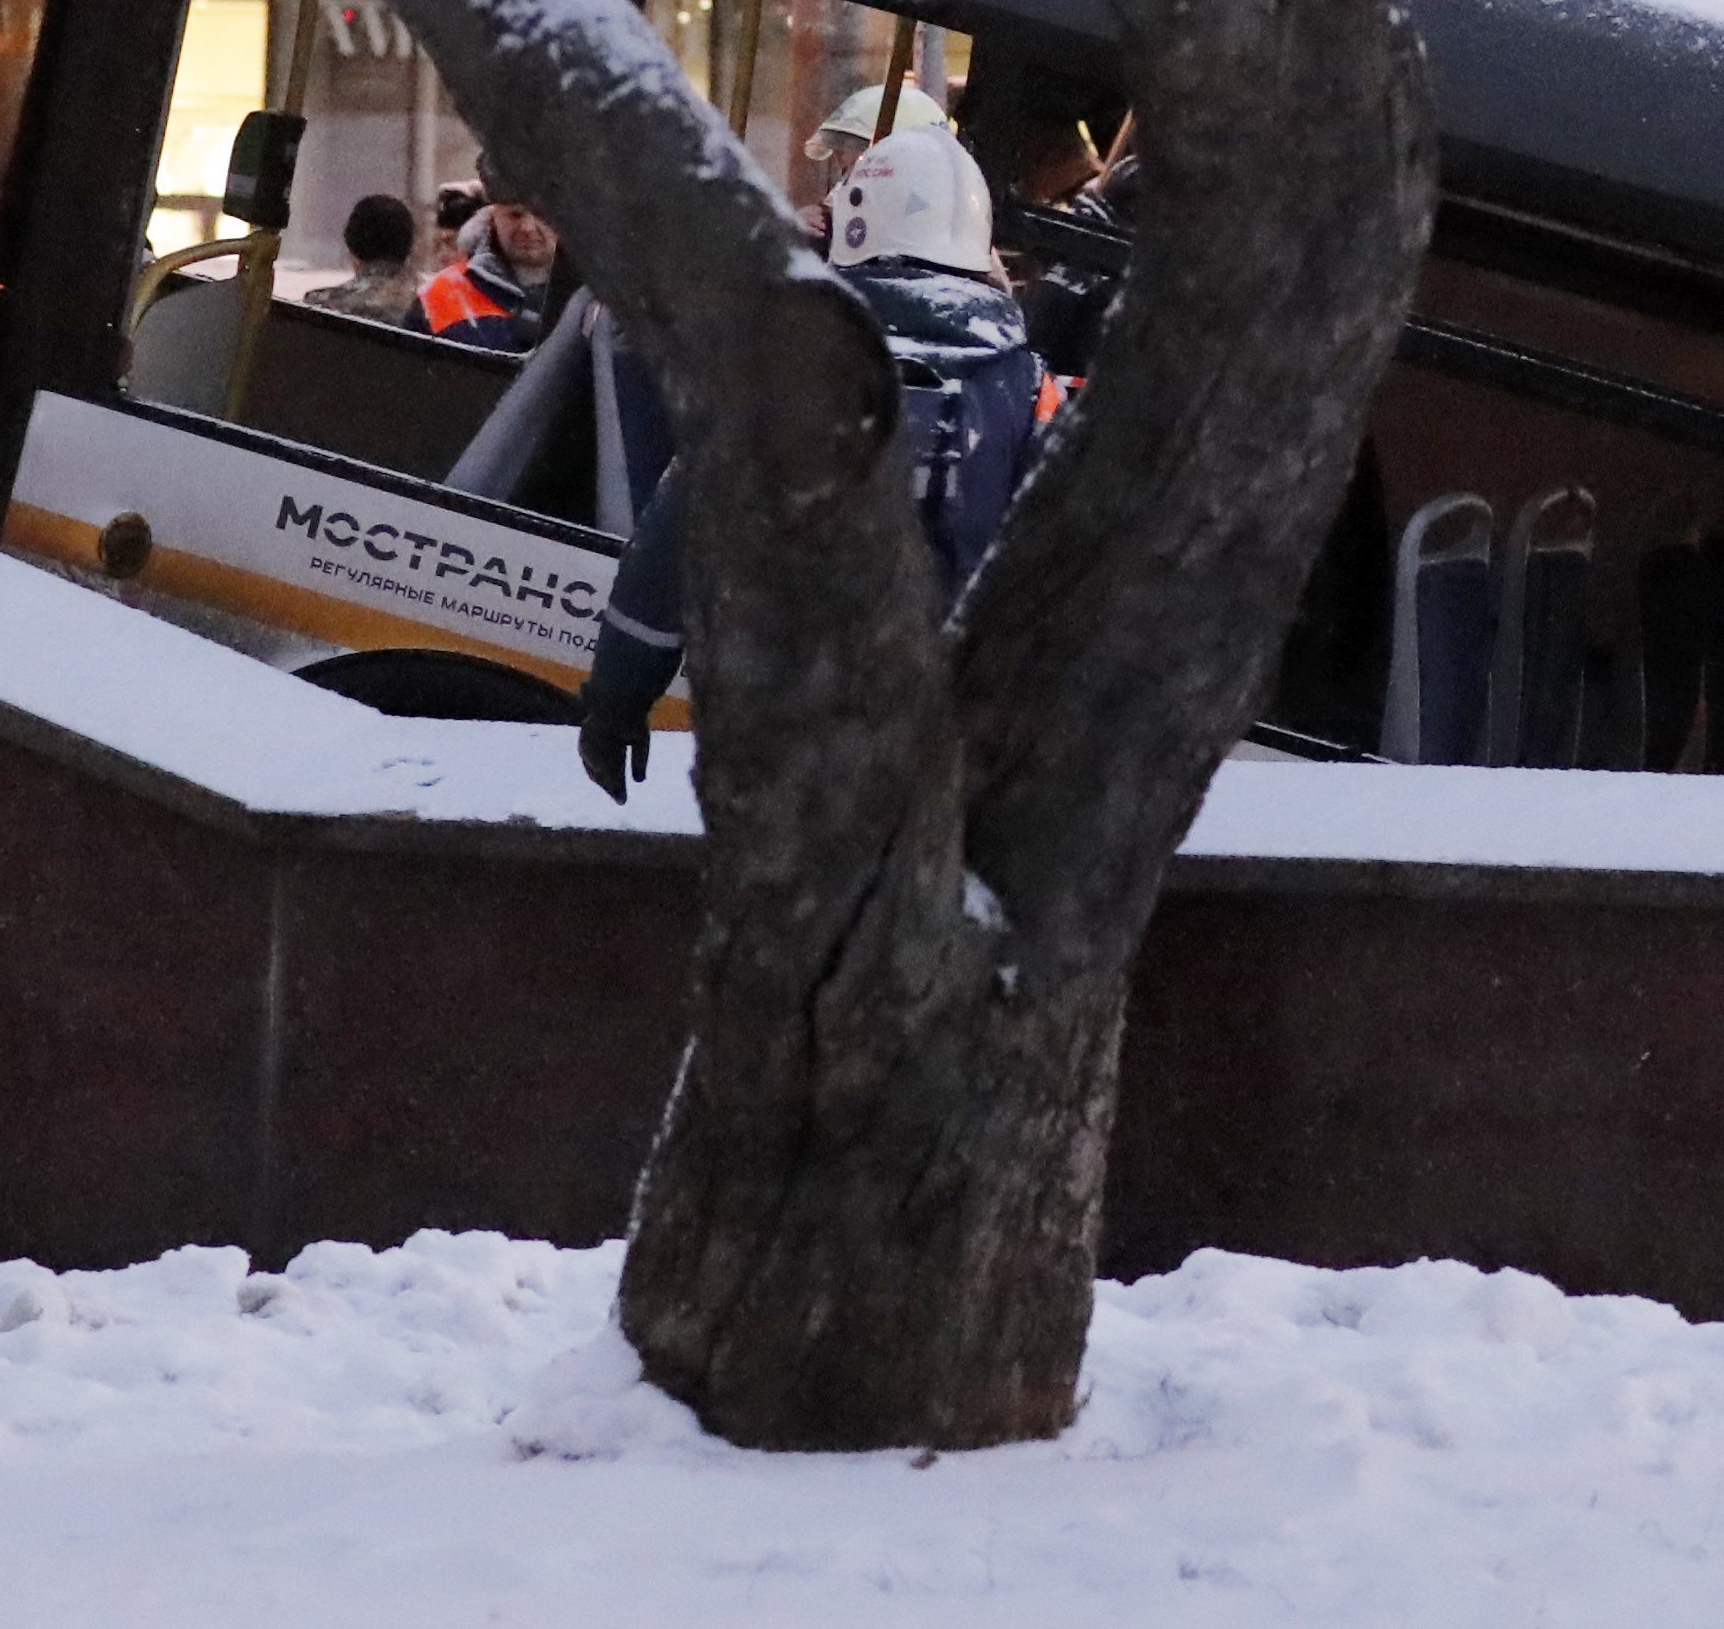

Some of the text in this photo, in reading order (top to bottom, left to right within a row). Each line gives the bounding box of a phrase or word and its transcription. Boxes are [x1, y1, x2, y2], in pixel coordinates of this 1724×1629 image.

[275, 495, 604, 622] МОСТРАНС
[309, 556, 435, 605] РЕГУЛЯРНЫЕ
[440, 595, 554, 639] МАРШРУТЫ
